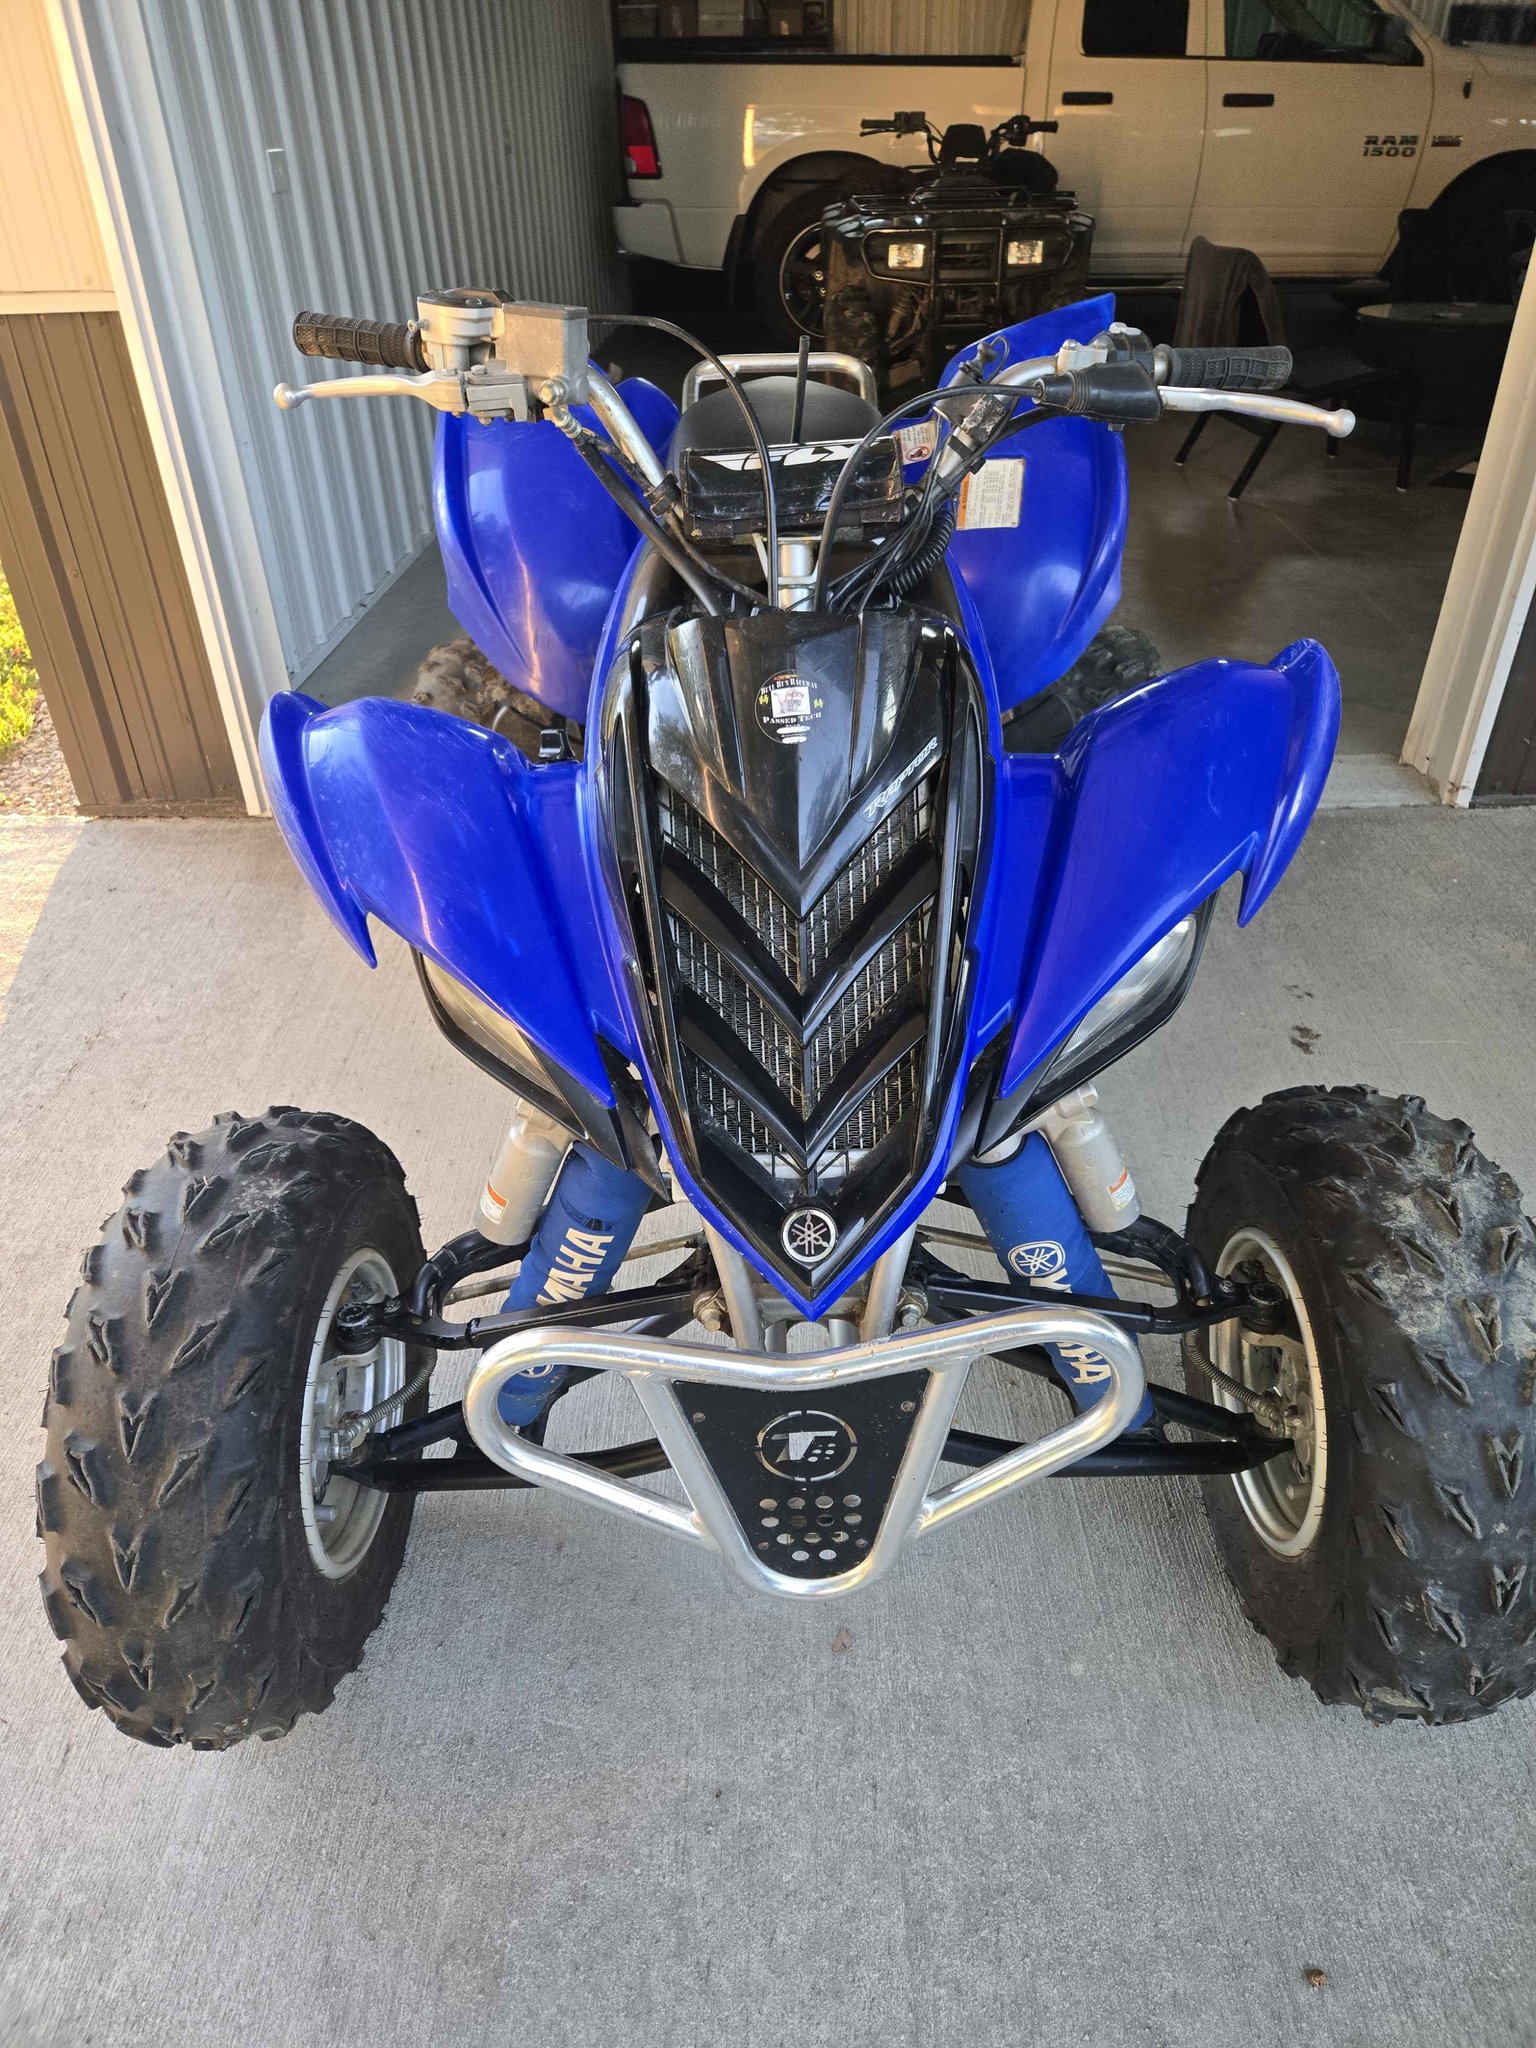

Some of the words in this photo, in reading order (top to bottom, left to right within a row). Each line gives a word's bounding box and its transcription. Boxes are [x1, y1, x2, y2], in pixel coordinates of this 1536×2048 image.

[1362, 146, 1416, 158] 1500
[1365, 135, 1418, 145] RAM
[862, 736, 938, 818] RAPTOR
[536, 1227, 615, 1306] MAHA
